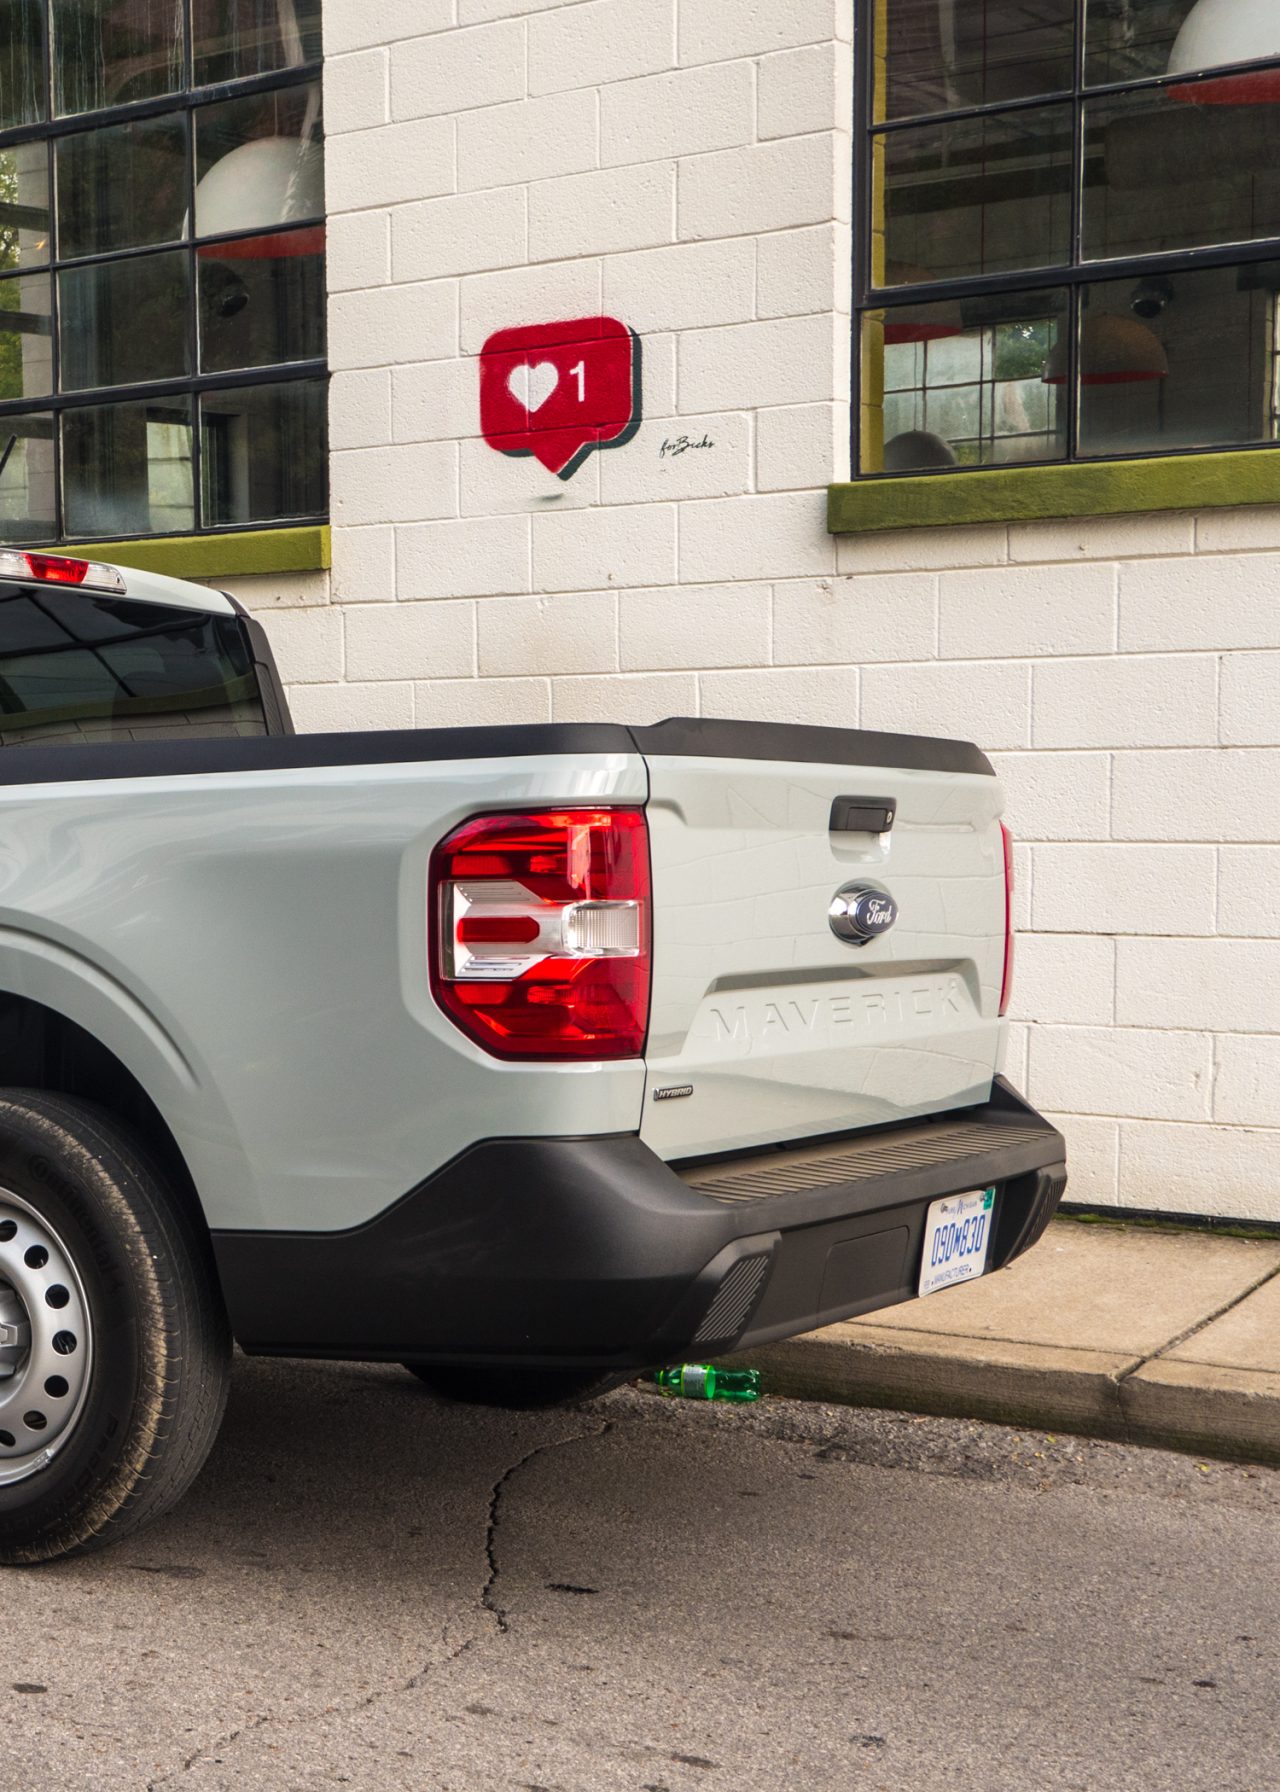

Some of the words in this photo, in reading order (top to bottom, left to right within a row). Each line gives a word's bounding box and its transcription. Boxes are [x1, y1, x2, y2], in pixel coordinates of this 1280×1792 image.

[569, 360, 585, 403] 1
[866, 899, 892, 925] Ford
[710, 981, 960, 1041] MAVERICK
[659, 1086, 693, 1099] HYBRID
[931, 1214, 986, 1268] 090M830
